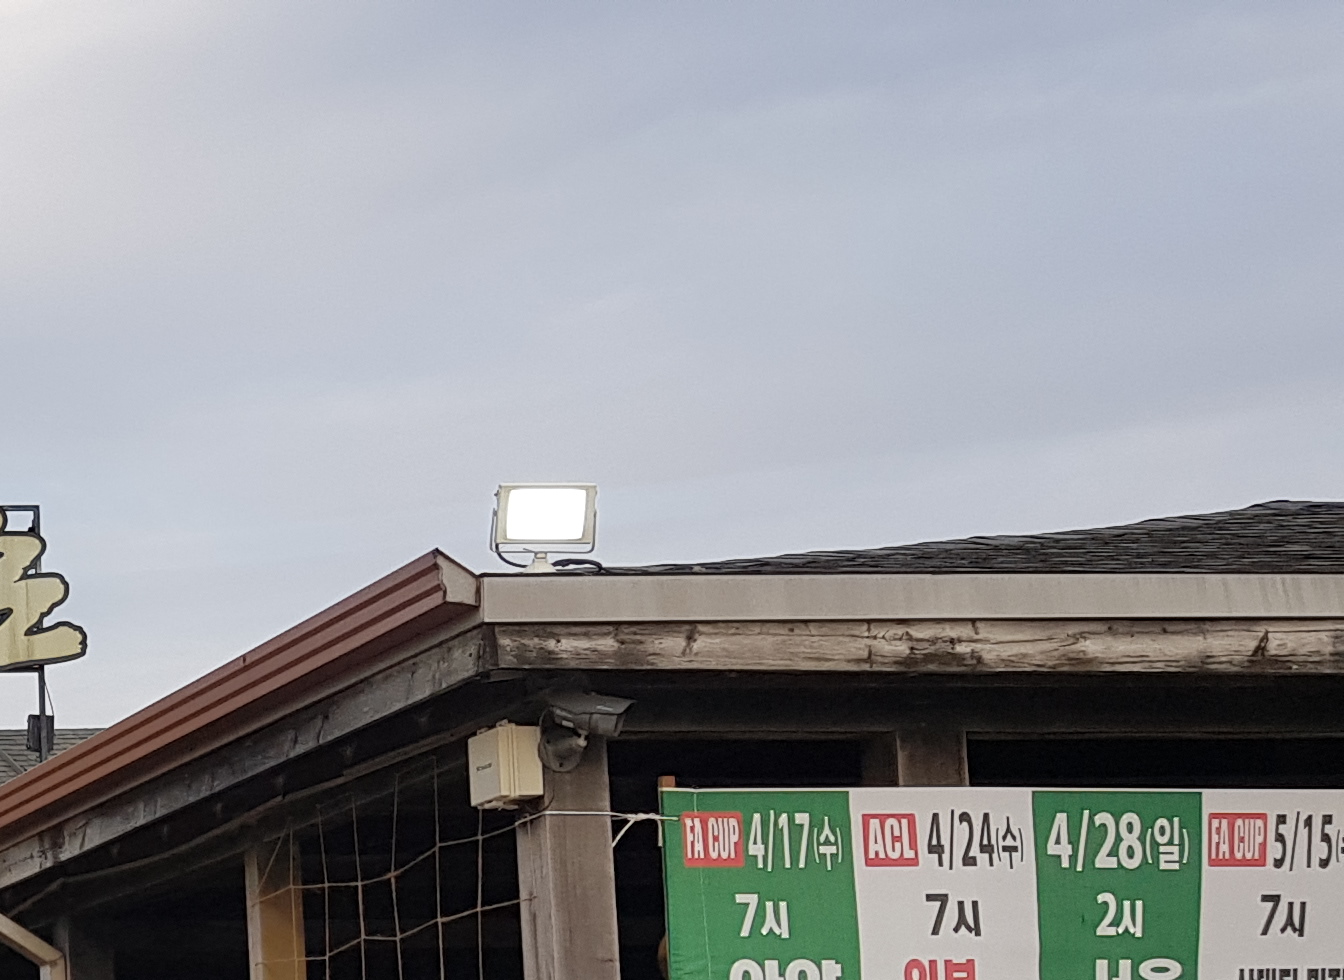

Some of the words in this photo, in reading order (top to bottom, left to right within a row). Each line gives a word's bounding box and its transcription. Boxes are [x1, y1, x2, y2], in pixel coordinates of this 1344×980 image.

[684, 817, 704, 859] FA
[708, 817, 739, 859] CUP
[748, 810, 843, 871] 4/17(수)
[868, 818, 916, 860] ACL
[928, 809, 1024, 870] 4/24(수)
[1046, 809, 1189, 872] 4/28(일)
[1211, 818, 1230, 860] FA
[1234, 818, 1265, 860] CUP
[735, 894, 789, 939] 7시
[926, 893, 982, 937] 7시
[1095, 892, 1143, 938] 2시
[1260, 894, 1307, 938] 7시
